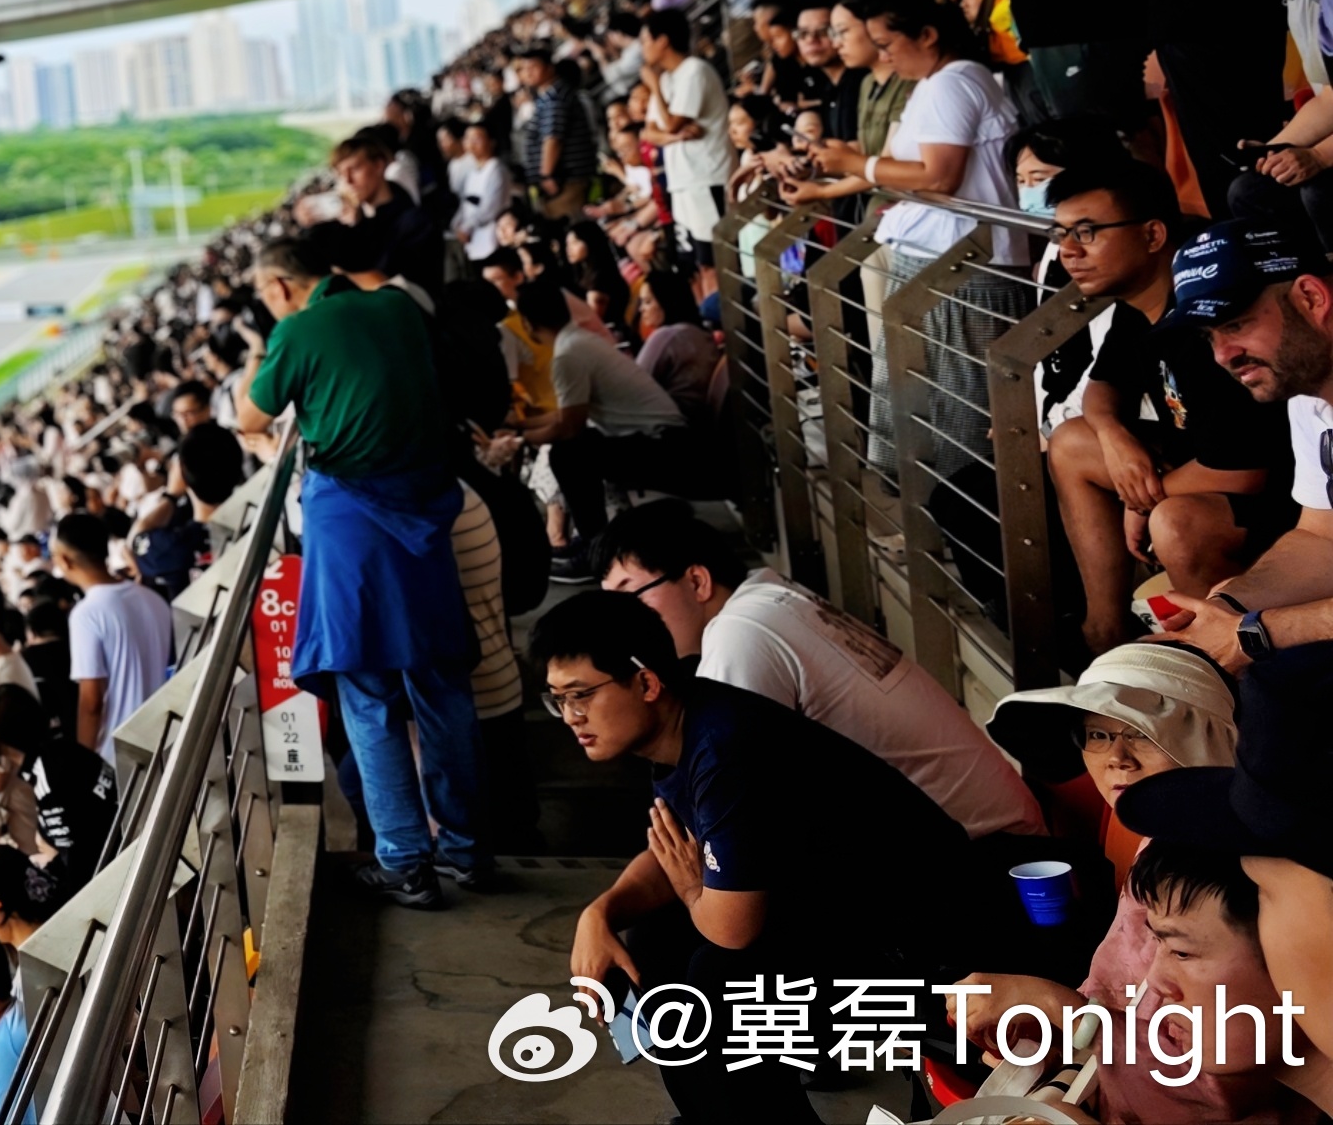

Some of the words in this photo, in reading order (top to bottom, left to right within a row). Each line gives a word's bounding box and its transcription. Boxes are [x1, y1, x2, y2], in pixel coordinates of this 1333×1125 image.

[270, 620, 287, 633] 01
[274, 645, 292, 659] 10
[281, 711, 296, 723] 01
[283, 732, 299, 743] 22
[284, 764, 304, 772] SEAT
